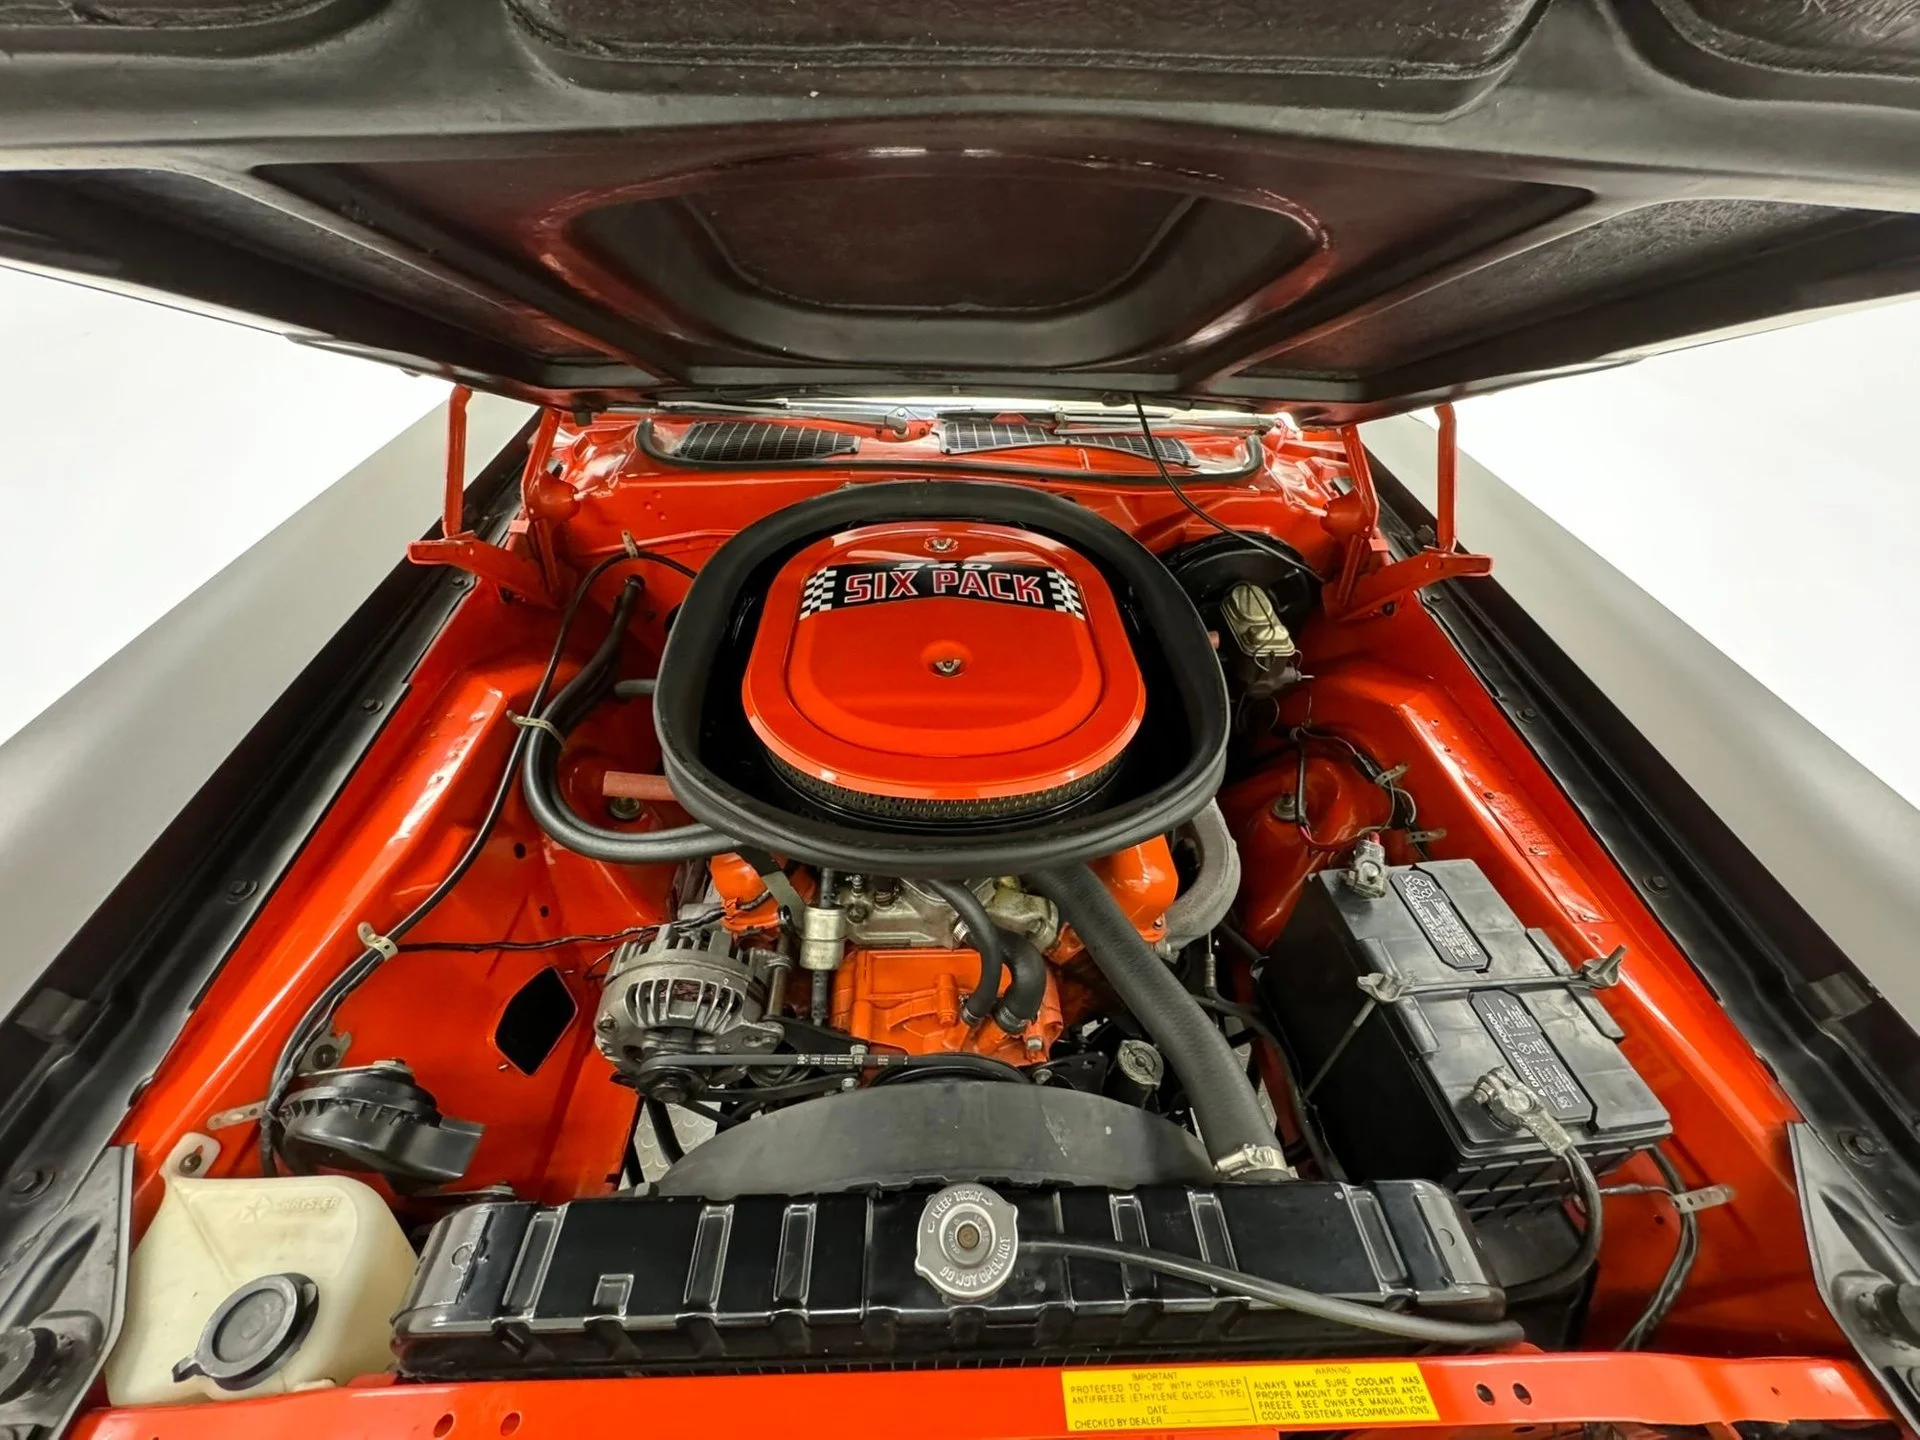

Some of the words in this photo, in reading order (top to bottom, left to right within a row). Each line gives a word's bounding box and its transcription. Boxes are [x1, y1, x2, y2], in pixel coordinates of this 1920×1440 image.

[892, 562, 992, 571] 340
[843, 571, 919, 604] SIX
[932, 570, 1044, 605] PACK
[1486, 1012, 1511, 1044] POISON
[1511, 1051, 1540, 1088] DANGER
[1132, 1371, 1178, 1381] IMPORTANT
[1314, 1366, 1351, 1376] WARNING
[1070, 1384, 1124, 1395] PROTECTED
[1128, 1383, 1141, 1393] TO
[1170, 1381, 1192, 1390] WITH
[1196, 1379, 1242, 1389] CHRYSLER
[1254, 1380, 1287, 1390] ALWAYS
[1293, 1378, 1318, 1388] MAKE
[1324, 1377, 1349, 1388] SURE
[1354, 1376, 1395, 1387] COOLANT
[1401, 1375, 1420, 1385] HAS
[1072, 1394, 1126, 1404] ANTIFREEZE
[1181, 1390, 1216, 1401] GLYCOL
[1256, 1389, 1292, 1400] PROPER
[1296, 1388, 1332, 1399] AMOUNT
[1336, 1387, 1347, 1398] OF
[1352, 1386, 1397, 1397] CHRYSLER
[1301, 1398, 1319, 1409] SEE
[1369, 1395, 1405, 1407] MANUAL
[1409, 1394, 1428, 1405] FOR
[1147, 1405, 1169, 1415] DATE
[1261, 1410, 1301, 1421] COOLING
[1303, 1408, 1344, 1420] SYSTEMS
[1074, 1419, 1117, 1430] CHECKED
[1117, 1418, 1128, 1428] BY
[1129, 1416, 1163, 1427] DEALER
